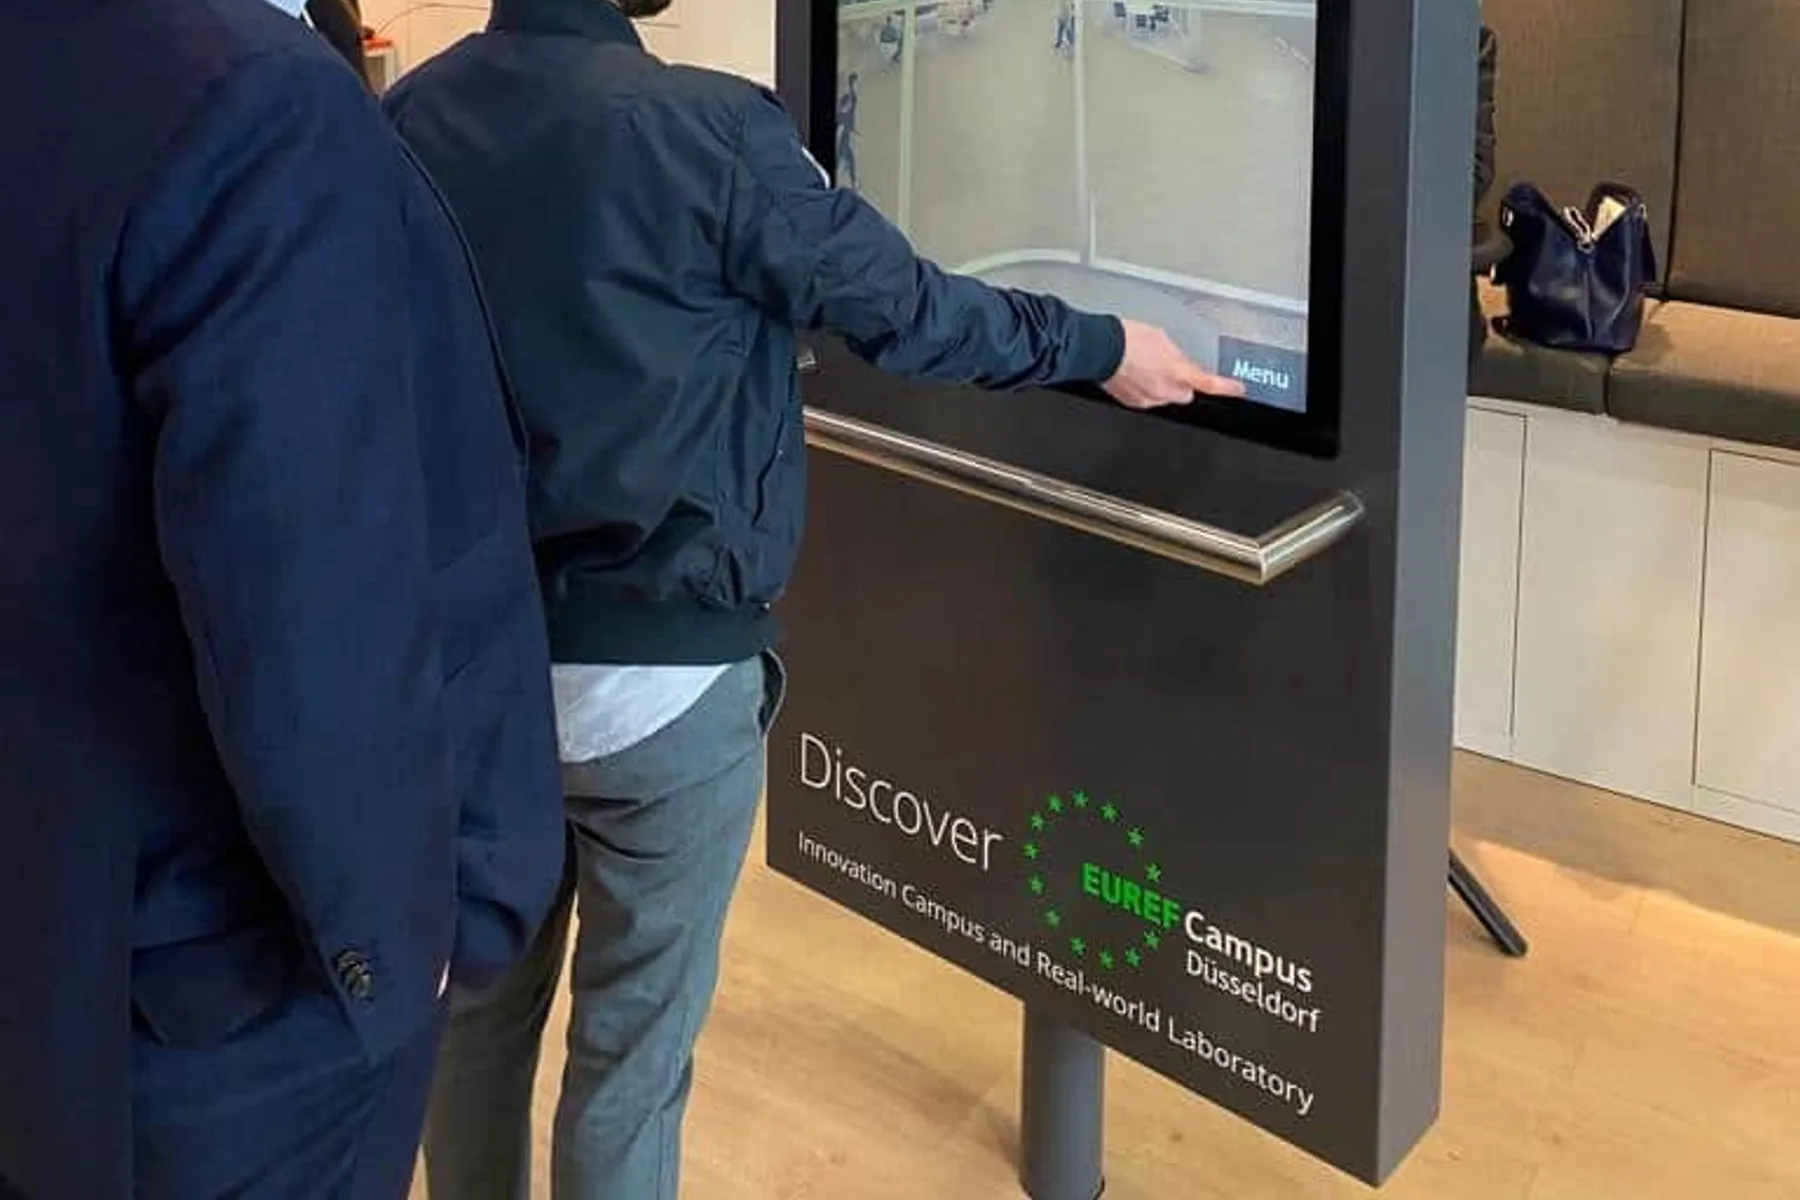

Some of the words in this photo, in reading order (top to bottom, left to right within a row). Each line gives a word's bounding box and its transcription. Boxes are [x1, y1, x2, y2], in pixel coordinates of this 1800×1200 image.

[1232, 357, 1289, 389] Menu
[800, 732, 1002, 870] Discover
[799, 831, 896, 898] Innovation
[902, 885, 984, 943] Campus
[990, 931, 1031, 966] and
[1037, 951, 1160, 1033] Real-world
[1169, 1017, 1313, 1116] Laboratory
[1081, 862, 1180, 929] EUREF
[1184, 910, 1313, 993] Campus
[1187, 948, 1321, 1032] Düsseldorf
